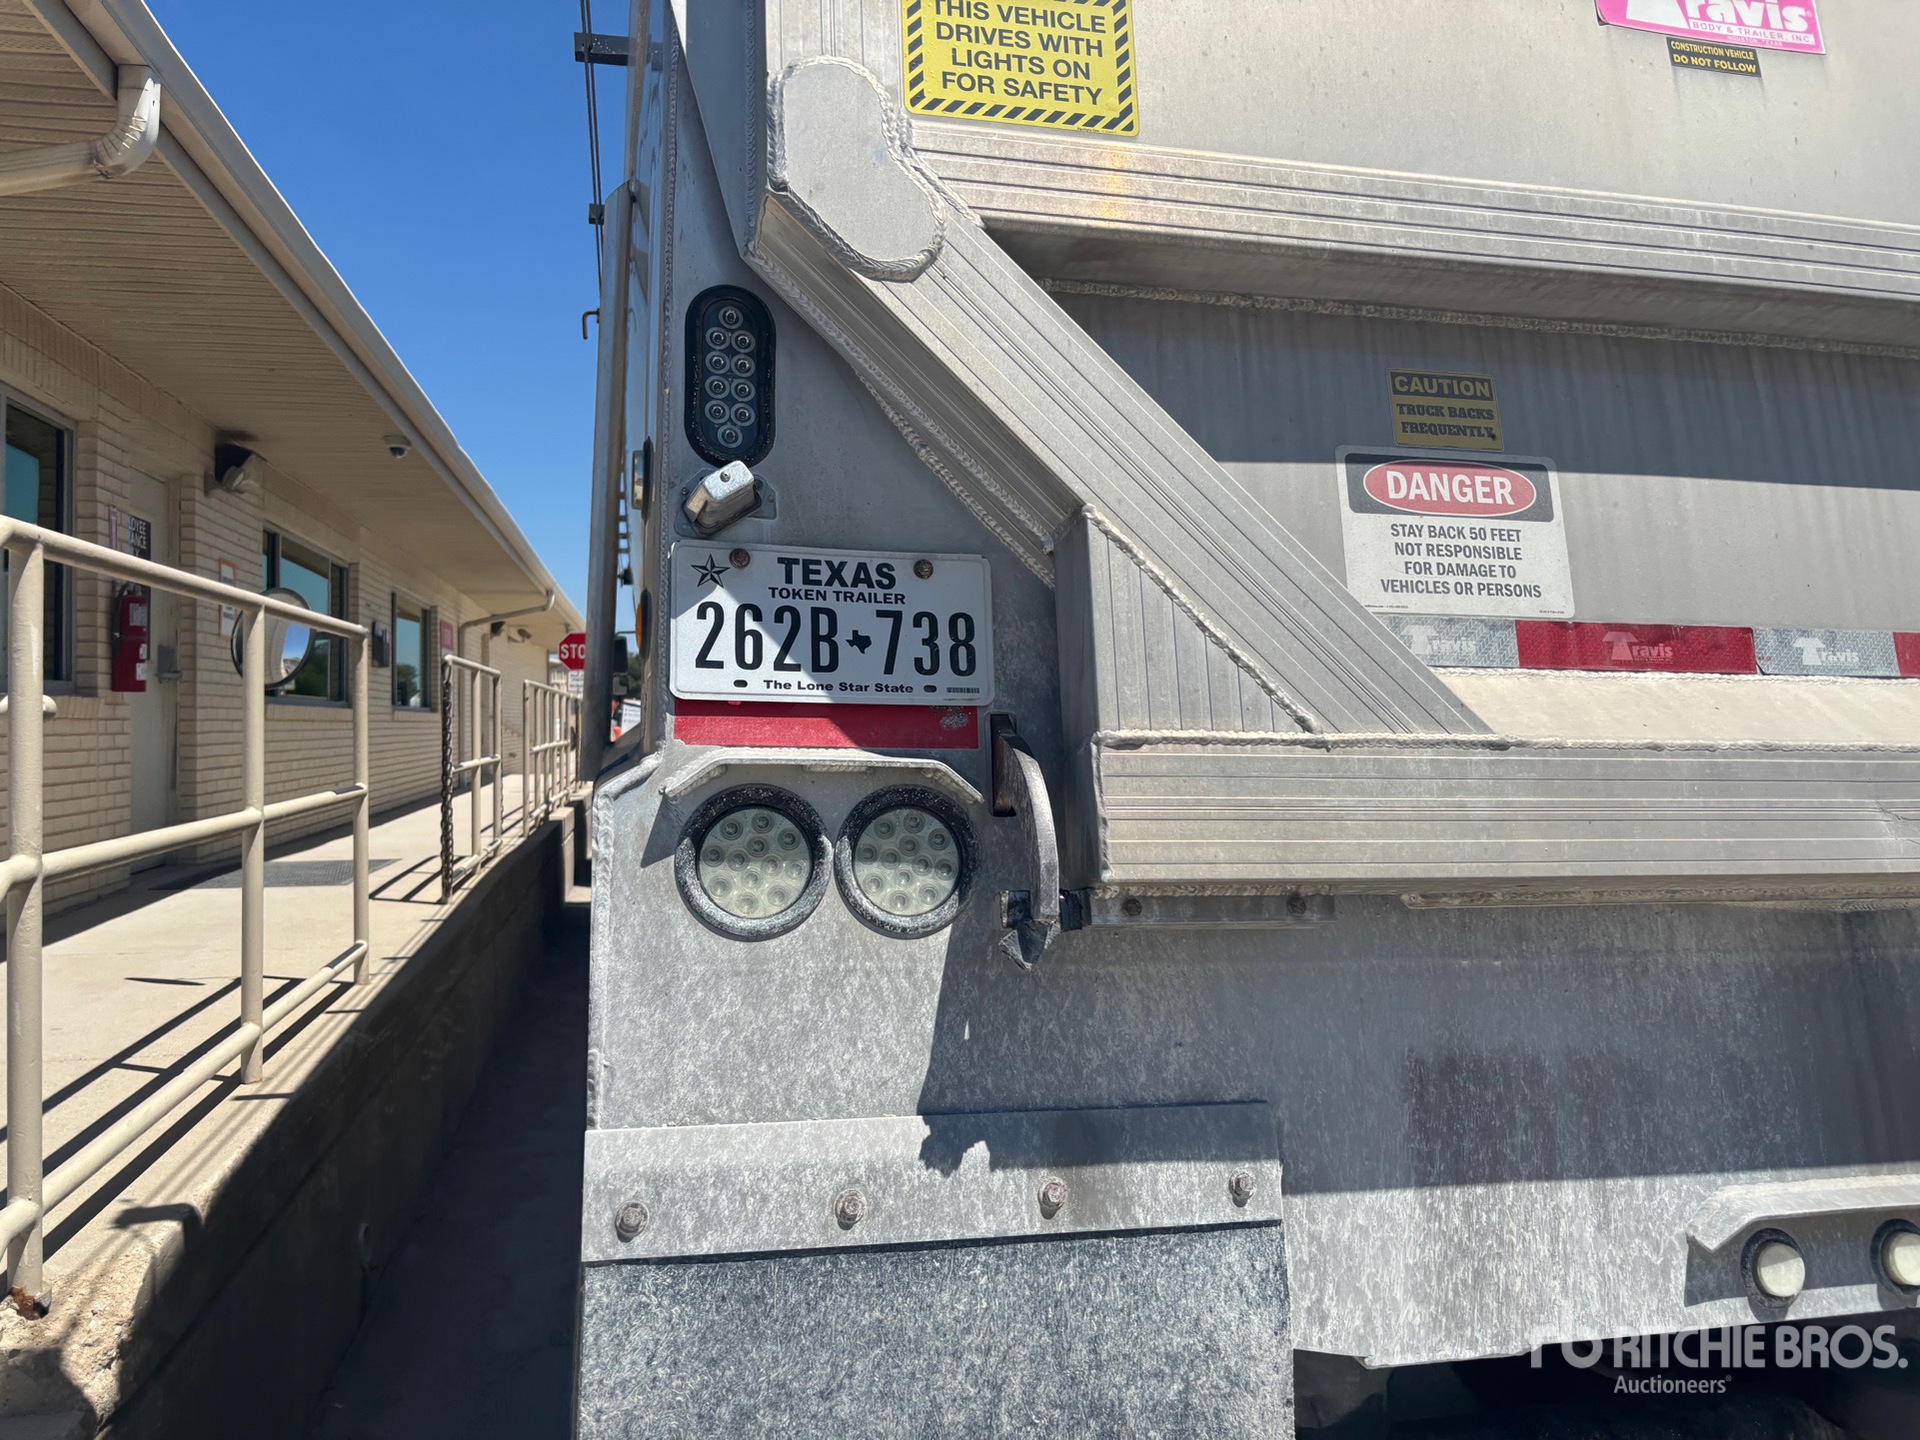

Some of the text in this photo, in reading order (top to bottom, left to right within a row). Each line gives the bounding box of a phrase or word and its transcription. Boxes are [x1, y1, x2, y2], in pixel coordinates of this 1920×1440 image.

[934, 0, 1106, 34] THIS VEHICLE
[1692, 21, 1722, 32] BODY
[1726, 26, 1734, 34] &
[936, 21, 1104, 57] DRIVES WITH
[1670, 40, 1755, 60] CONSTRUCTION VEHICLE
[952, 48, 1091, 80] LIGHTS ON
[1673, 54, 1757, 73] DO NOT FOLLOW
[942, 71, 1103, 106] FOR SAFETY
[1394, 375, 1490, 398] CAUTION
[1396, 403, 1495, 421] TRUCK BACKS
[1401, 422, 1495, 438] FREQUENTLY
[1386, 470, 1516, 506] DANGER
[1391, 523, 1522, 542] STAY BACK 50 FEET
[1394, 542, 1523, 561] NOT RESPONSIBLE
[777, 557, 897, 590] TEXAS
[1404, 562, 1517, 578] FOR DAMAGE TO
[768, 587, 906, 605] TOKEN TRAILER
[1381, 579, 1542, 599] VEHICLES OR PERSONS
[695, 601, 977, 677] 262B 738
[1602, 632, 1673, 660] Travis
[560, 643, 586, 660] STO
[763, 679, 914, 693] The Lone Star State
